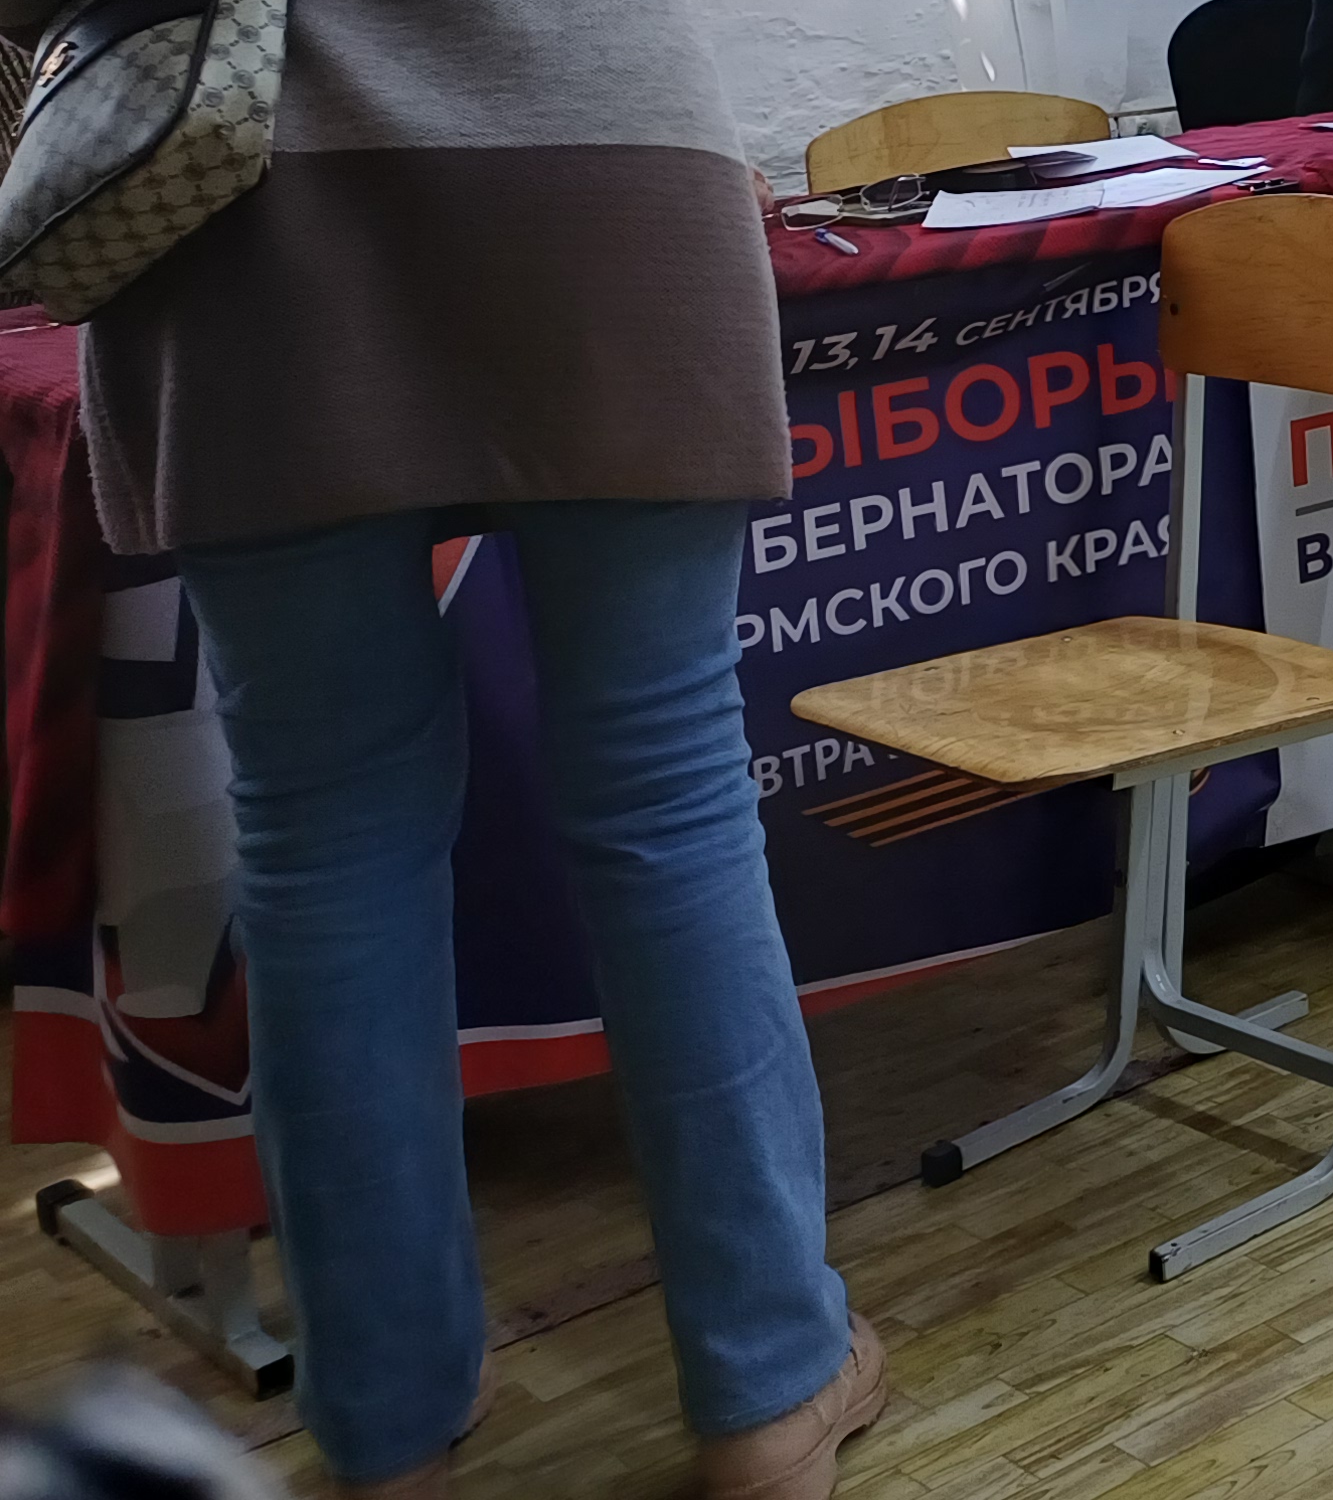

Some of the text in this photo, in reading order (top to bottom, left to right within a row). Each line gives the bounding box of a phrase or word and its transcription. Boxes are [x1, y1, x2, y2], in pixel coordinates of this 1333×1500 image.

[790, 342, 1178, 480] ЫБОРЫ
[751, 433, 1173, 575] БЕРНАТОРА
[733, 550, 1028, 654] РМСКОГО
[752, 737, 876, 800] ВТРА
